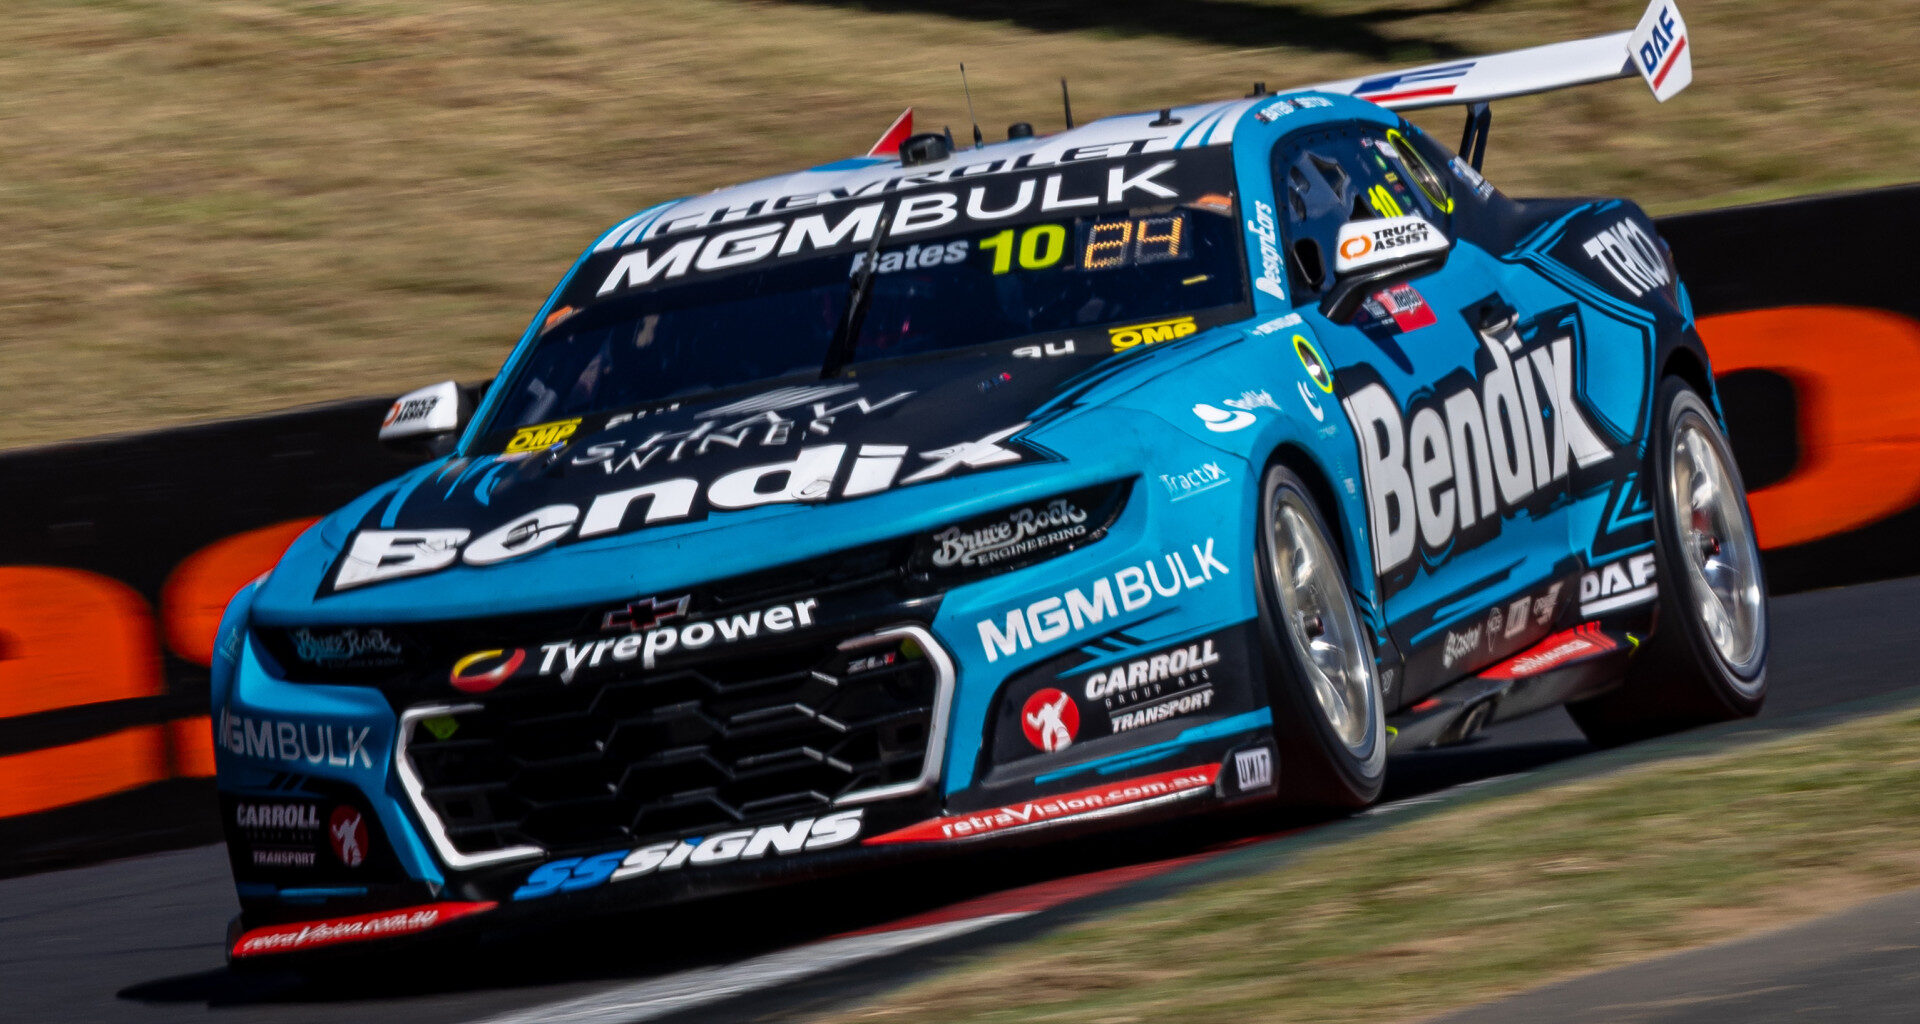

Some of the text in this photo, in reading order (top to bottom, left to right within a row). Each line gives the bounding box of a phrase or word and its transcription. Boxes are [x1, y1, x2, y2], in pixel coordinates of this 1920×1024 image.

[1639, 5, 1675, 76] DAF
[652, 134, 1168, 237] CHEVROLET
[1367, 184, 1405, 218] 10
[848, 222, 1068, 279] Bates 10
[1084, 216, 1184, 270] 24
[1372, 221, 1428, 241] TRUCK
[1373, 231, 1430, 252] ASSIST
[1582, 216, 1671, 298] TRICO
[1109, 319, 1199, 351] OMP
[504, 420, 580, 451] OMP
[1342, 332, 1616, 577] Bendix
[333, 421, 1031, 592] Bendix
[932, 499, 1088, 568] Bruce Rock
[976, 523, 1088, 567] ENGINEERING
[1579, 552, 1657, 602] DAF
[537, 597, 820, 686] Tyrepower
[1085, 638, 1220, 702] CARROLL
[1104, 682, 1163, 710] GROUP
[1110, 688, 1215, 735] TRANSPORT
[236, 804, 320, 830] CARROLL
[941, 773, 1211, 838] retraVision.com.au
[252, 850, 317, 866] TRANSPORT
